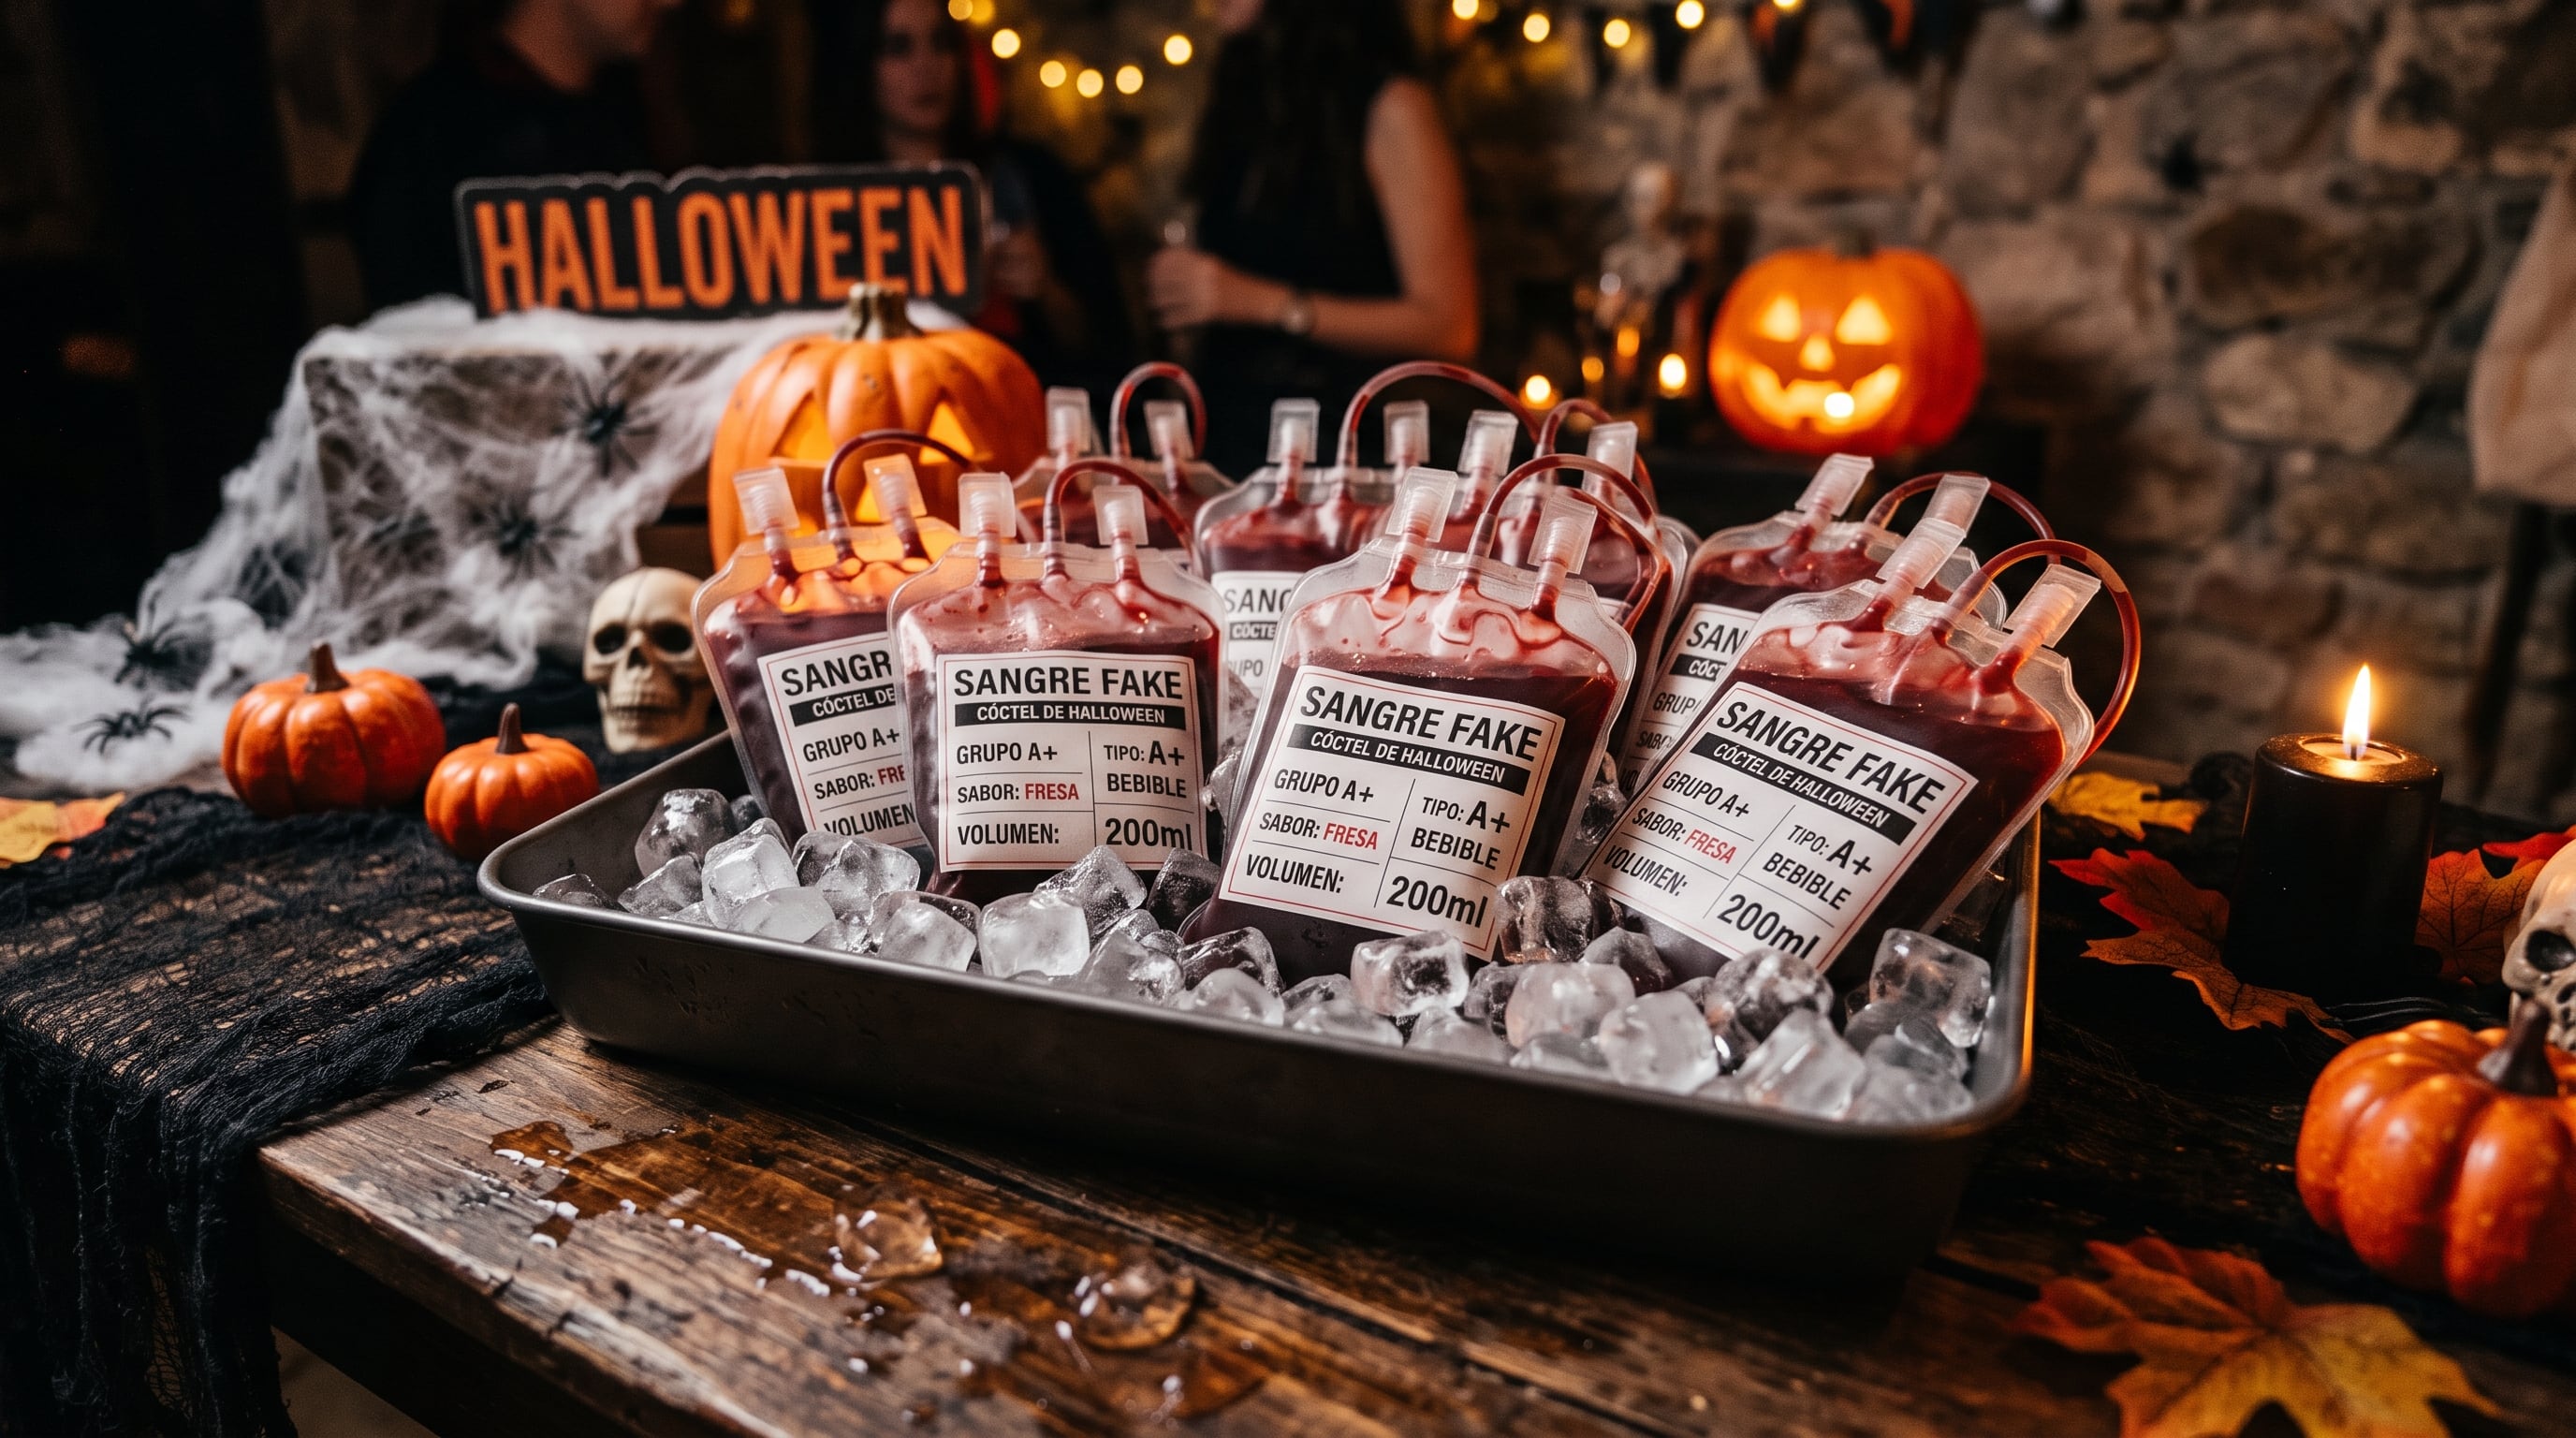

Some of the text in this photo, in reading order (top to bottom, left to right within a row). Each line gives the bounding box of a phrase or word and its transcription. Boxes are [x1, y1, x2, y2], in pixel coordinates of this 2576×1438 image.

[475, 186, 966, 313] HALLOWEEN
[812, 686, 896, 718] CÓCTEL DE
[954, 667, 1183, 700] SANGRE FAKE
[976, 703, 1165, 724] CÓCTEL DE HALLOWEEN
[1300, 685, 1543, 762] SANGRE FAKE
[803, 727, 900, 763] GRUPO A+
[956, 741, 1058, 765] GRUPO A+
[1103, 740, 1185, 767] TIPO: A+
[1310, 730, 1506, 784] CÓCTEL DE HALLOWEEN
[1717, 700, 1946, 814] SANGRE FAKE
[813, 771, 876, 800] SABOR:
[957, 783, 1079, 803] SABOR: FRESA
[1106, 773, 1187, 799] BEBIBLE
[1274, 769, 1374, 802] GRUPO A+
[1661, 770, 1749, 818] GRUPO A+
[1713, 743, 1891, 829] CÓCTEL DE HALLOWEEN
[958, 823, 1060, 845] VOLUMEN:
[1105, 817, 1193, 851] 200ml
[1259, 812, 1379, 850] SABOR: FRESA
[1422, 797, 1511, 834] TIPO: A+
[1411, 827, 1501, 871] BEBIBLE
[1632, 807, 1737, 865] SABOR: FRESA
[1787, 824, 1872, 876] TIPO: A+
[1246, 854, 1345, 893] VOLUMEN:
[1603, 844, 1688, 897] VOLUMEN:
[1763, 851, 1852, 911] BEBIBLE
[1386, 875, 1488, 928] 200ml
[1717, 894, 1820, 960] 200ml
